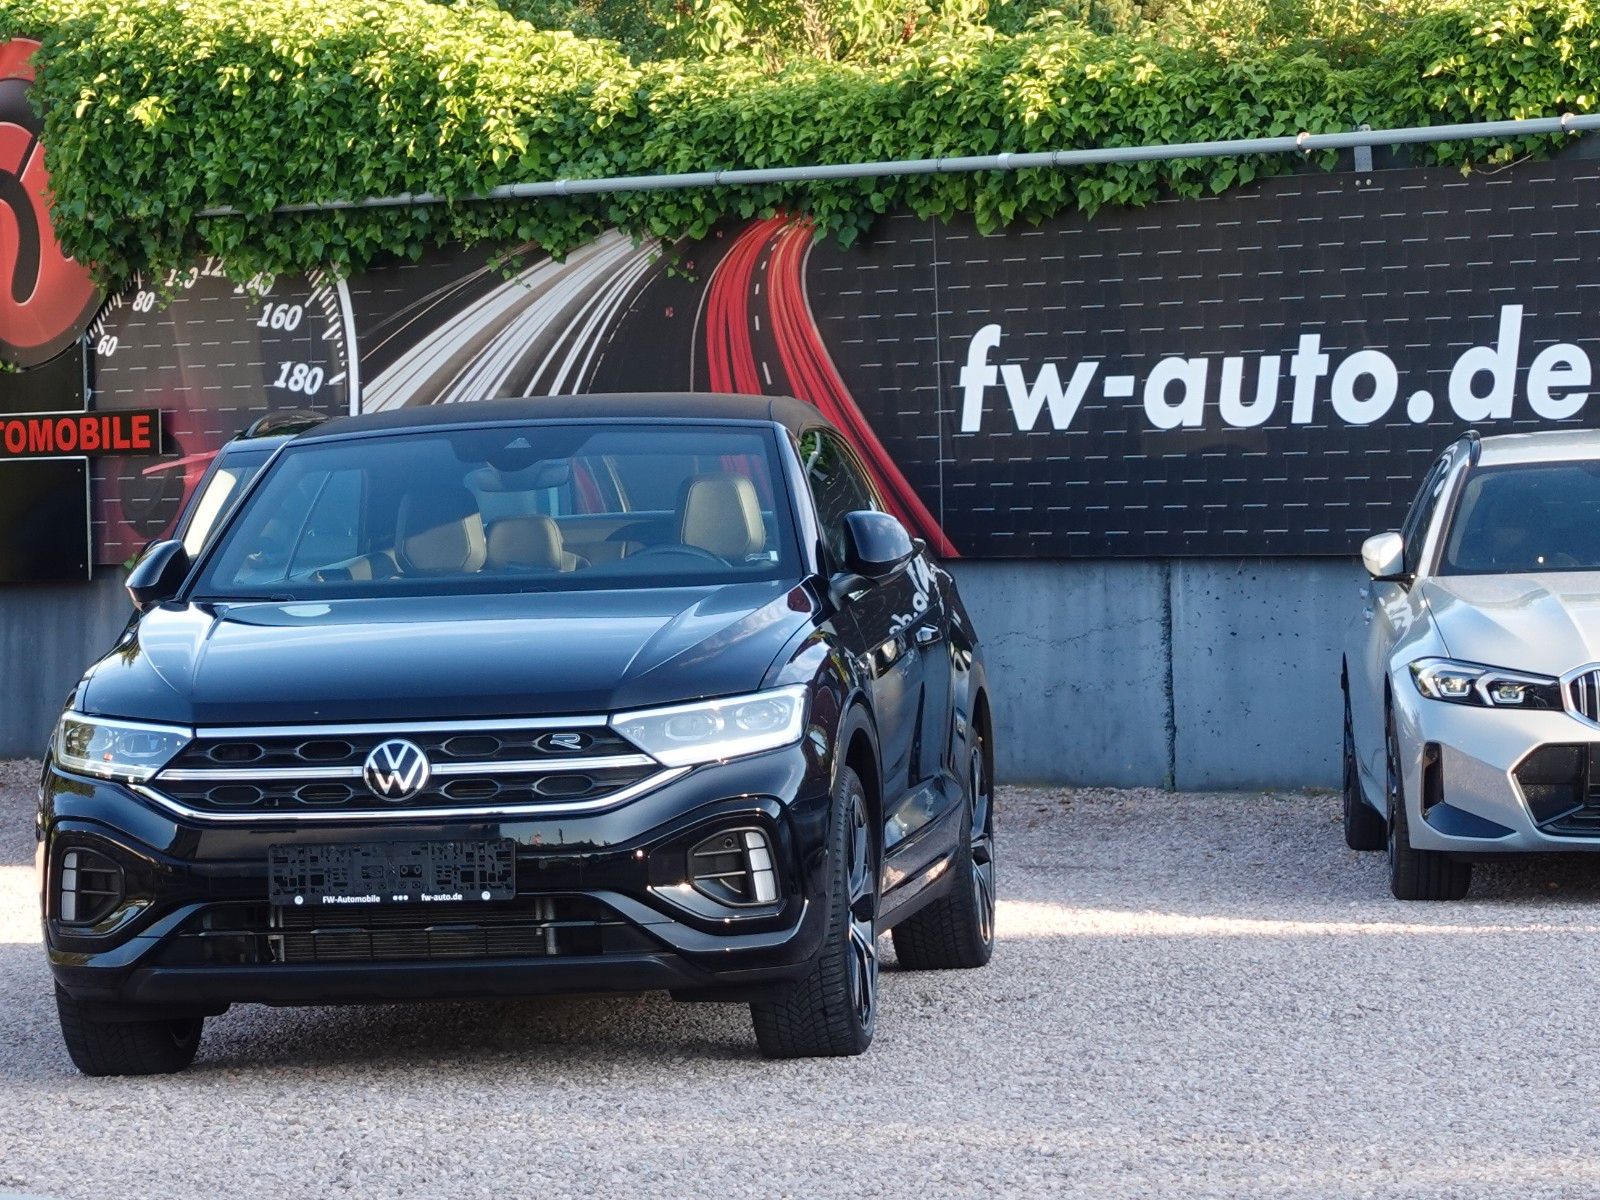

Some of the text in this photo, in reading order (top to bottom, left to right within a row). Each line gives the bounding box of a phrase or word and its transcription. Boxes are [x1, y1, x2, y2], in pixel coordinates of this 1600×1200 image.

[165, 267, 198, 289] 10
[201, 256, 226, 277] 12
[132, 290, 155, 312] 80
[256, 302, 303, 331] 160
[97, 334, 118, 357] 60
[273, 361, 324, 395] 180
[959, 304, 1592, 432] fw-auto.de
[0, 415, 151, 454] OMOBILE
[322, 892, 463, 904] FW-Automobile fw-auto.de
